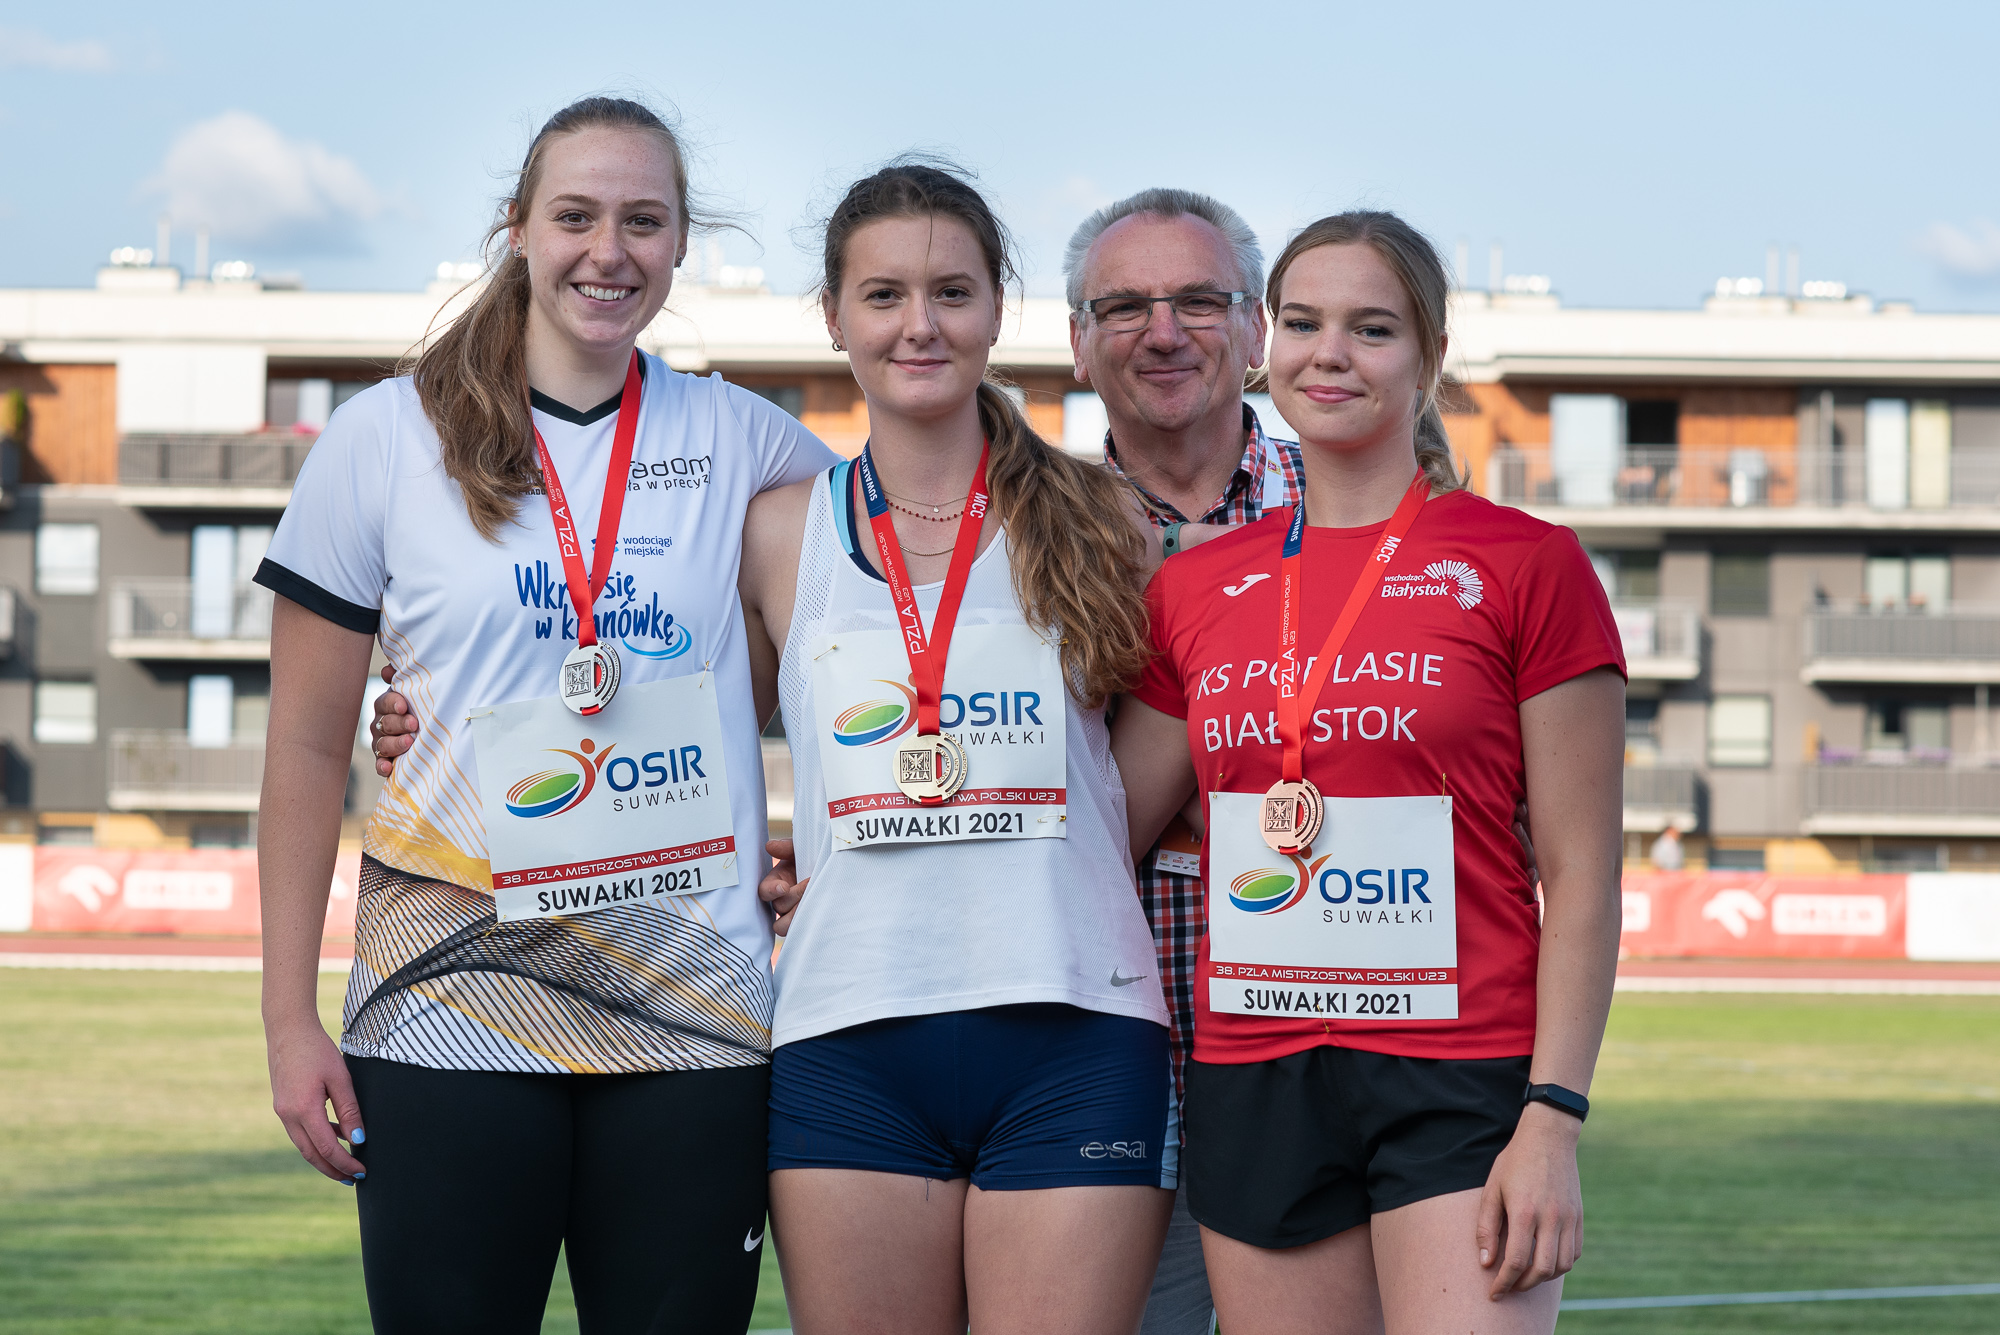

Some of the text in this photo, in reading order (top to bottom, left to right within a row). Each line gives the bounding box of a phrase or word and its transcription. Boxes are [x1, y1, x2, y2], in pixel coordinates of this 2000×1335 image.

[646, 480, 658, 490] w
[970, 492, 988, 518] MCC
[555, 506, 578, 557] PZLA
[623, 536, 673, 549] wodociągi
[878, 531, 889, 556] POLSKI
[624, 546, 665, 557] miejskie
[1376, 535, 1402, 563] MCC
[604, 572, 636, 601] się
[1381, 582, 1450, 599] Białystok
[1384, 574, 1426, 582] wschodzący
[902, 587, 911, 601] U23
[535, 617, 552, 639] w
[901, 604, 924, 654] PZLA
[1196, 663, 1233, 701] KS
[1281, 648, 1295, 698] PZLA
[567, 683, 590, 695] PZLA
[939, 691, 1043, 729] OSIR
[1204, 707, 1418, 752] BIAŁSTOK
[606, 744, 707, 793] OSIR
[903, 771, 929, 780] PZLA
[613, 783, 710, 812] SUWAŁKI
[833, 804, 848, 814] 38.
[849, 798, 877, 809] PZLA
[980, 792, 1026, 801] POLSKI
[1029, 791, 1057, 801] U23
[856, 812, 1024, 841] SUWAŁKI 2021
[1267, 820, 1290, 830] PZLA
[502, 840, 728, 886] 38. PZLA MISTRZOSTWA POLSKI U23
[537, 867, 703, 914] SUWAŁKI 2021
[1319, 868, 1432, 904] OSIR
[1323, 909, 1432, 923] SUWAŁKI
[1216, 966, 1447, 981] 38. PZLA MISTRZOSTWA POLSKI U23
[1243, 988, 1412, 1015] SUWAŁKI 2021
